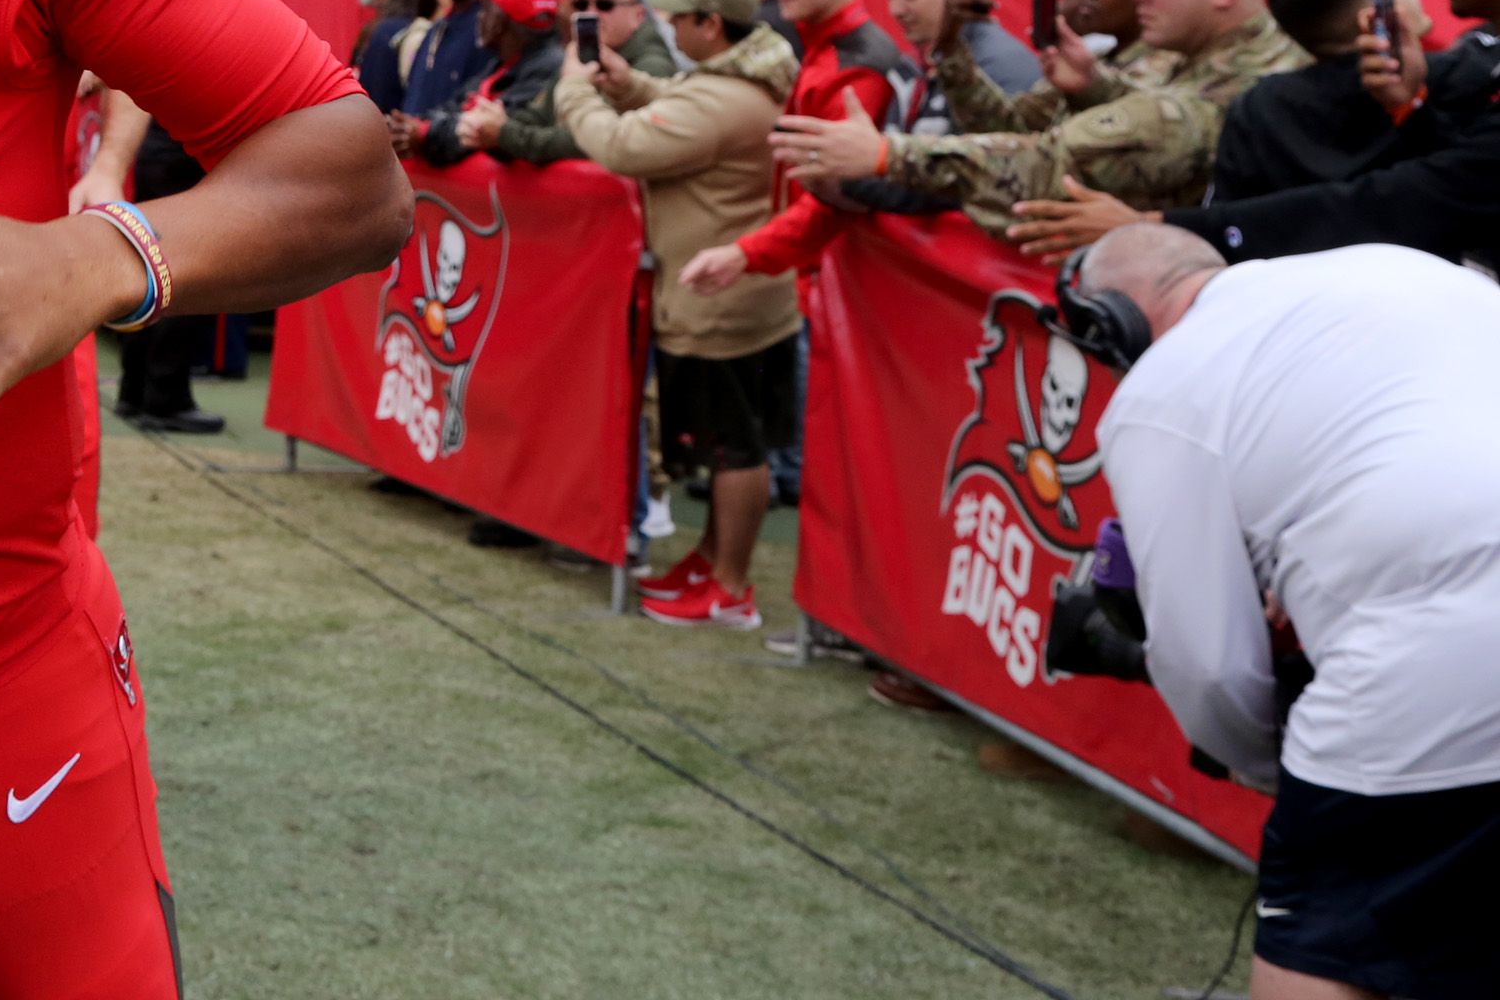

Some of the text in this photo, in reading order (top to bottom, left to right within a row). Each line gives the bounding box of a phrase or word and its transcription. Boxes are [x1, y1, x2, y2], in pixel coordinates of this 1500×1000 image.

[374, 368, 440, 462] BUCS
[384, 332, 433, 401] #GO
[954, 492, 1034, 597] #GO
[941, 545, 1040, 688] BUCS
